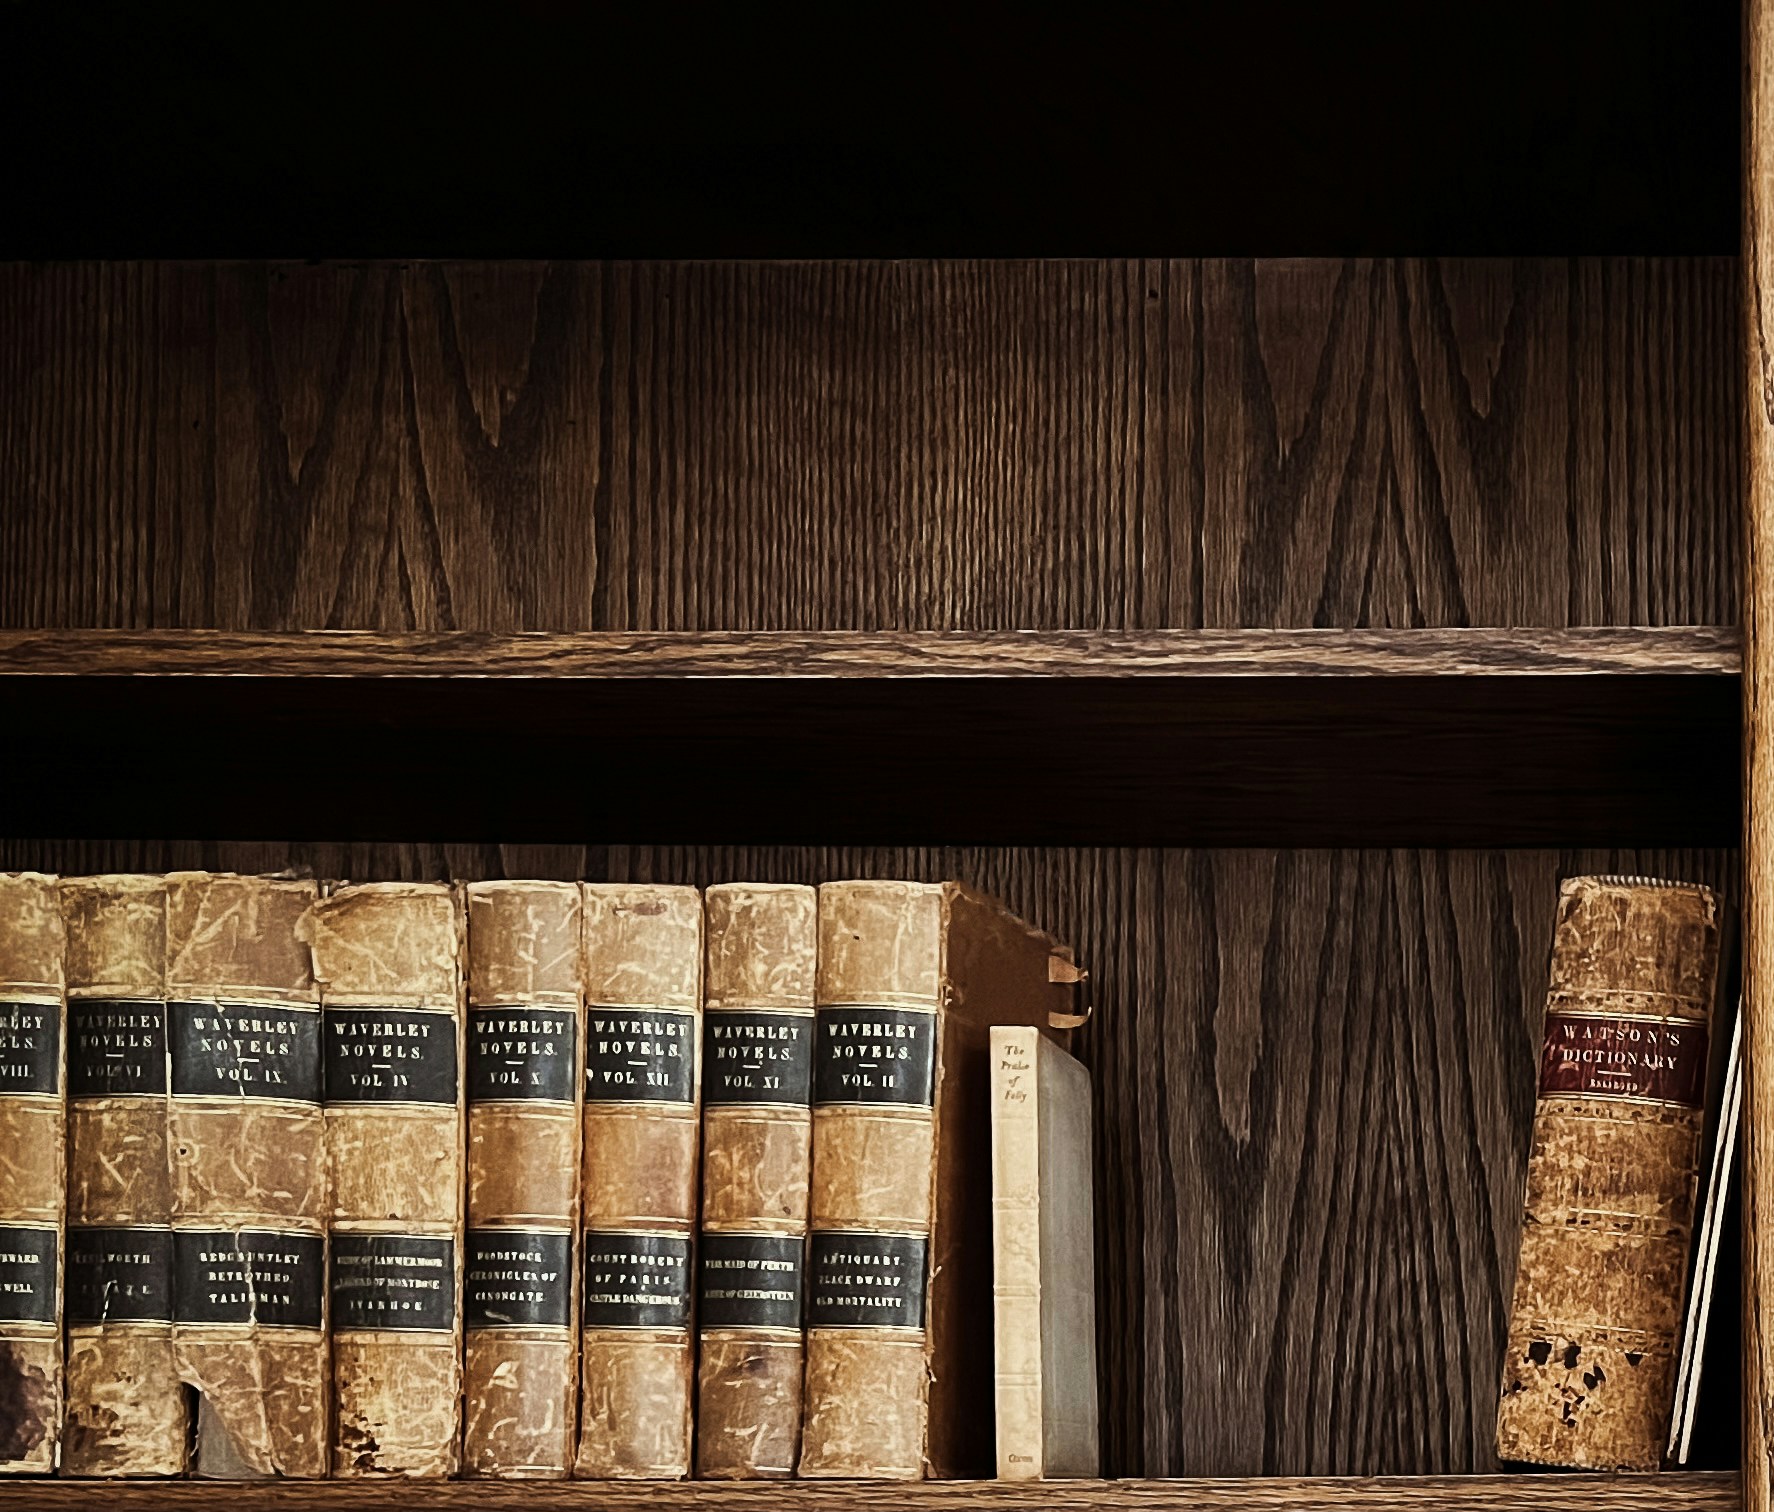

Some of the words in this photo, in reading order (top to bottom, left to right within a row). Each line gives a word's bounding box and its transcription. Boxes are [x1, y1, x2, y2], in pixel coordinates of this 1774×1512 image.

[334, 1023, 430, 1037] WAVERLEY
[594, 1021, 687, 1037] WAVERLEY
[713, 1024, 799, 1040] WAVERLEY
[828, 1024, 917, 1039] WAVERLEY
[1563, 1025, 1680, 1045] WATSON'S
[1563, 1049, 1677, 1069] DICTIONARY
